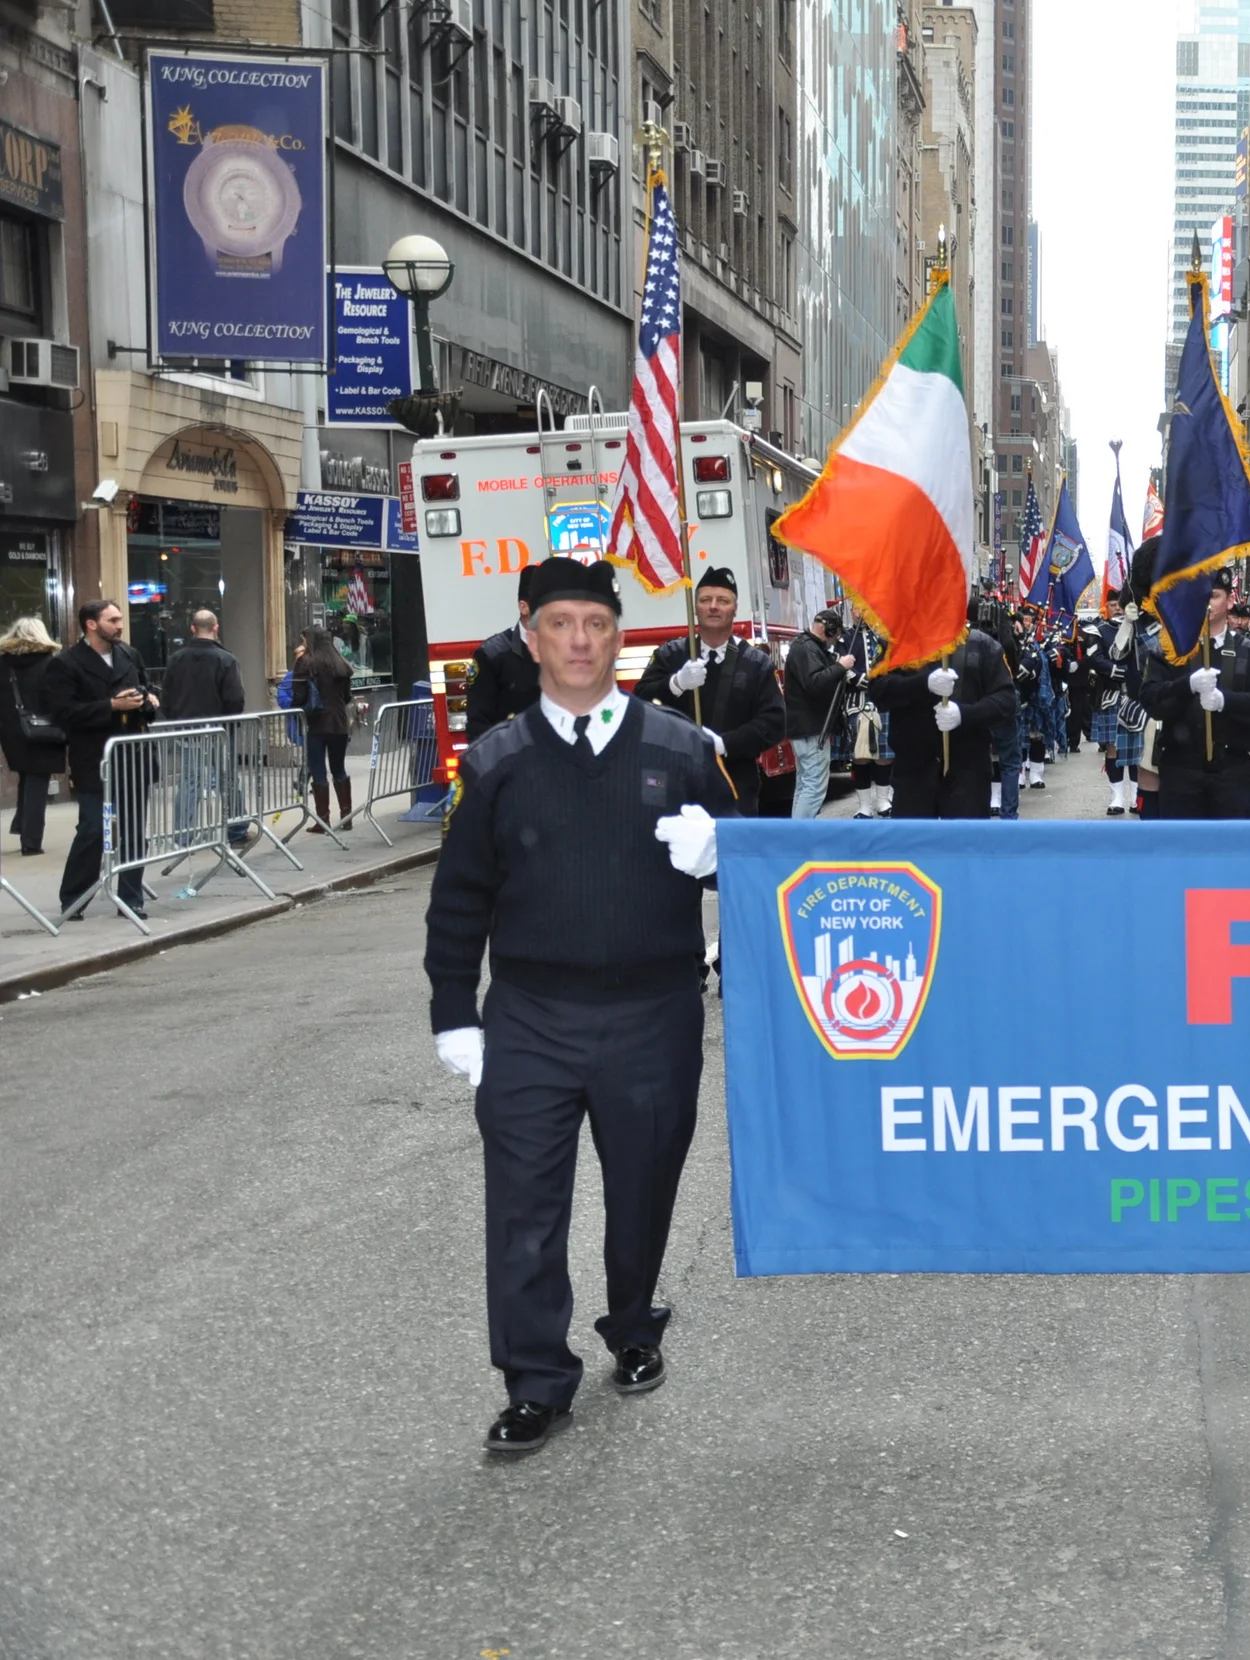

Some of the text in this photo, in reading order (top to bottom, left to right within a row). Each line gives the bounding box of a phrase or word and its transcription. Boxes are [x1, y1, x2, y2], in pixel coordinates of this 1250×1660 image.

[161, 66, 312, 88] KING COLLECTION
[0, 130, 48, 193] ORP.
[335, 283, 397, 300] THE JEWELER'S
[343, 300, 387, 316] RESOURCE
[168, 320, 315, 340] KING COLLECTION
[338, 326, 389, 336] Gemological &
[356, 335, 400, 345] Bench Tools
[338, 356, 383, 365] Packaging &
[357, 365, 384, 375] Display
[339, 386, 401, 395] Label & Bar Code
[478, 472, 618, 492] MOBILE OPERATIONS
[304, 494, 359, 508] KASSOY
[339, 507, 367, 515] RESOURCE
[299, 520, 332, 530] Packaging
[340, 523, 363, 532] Display
[797, 876, 925, 919] FIRE DEPARTMENT
[831, 899, 891, 912] CITY OF
[820, 916, 903, 929] NEW YORK
